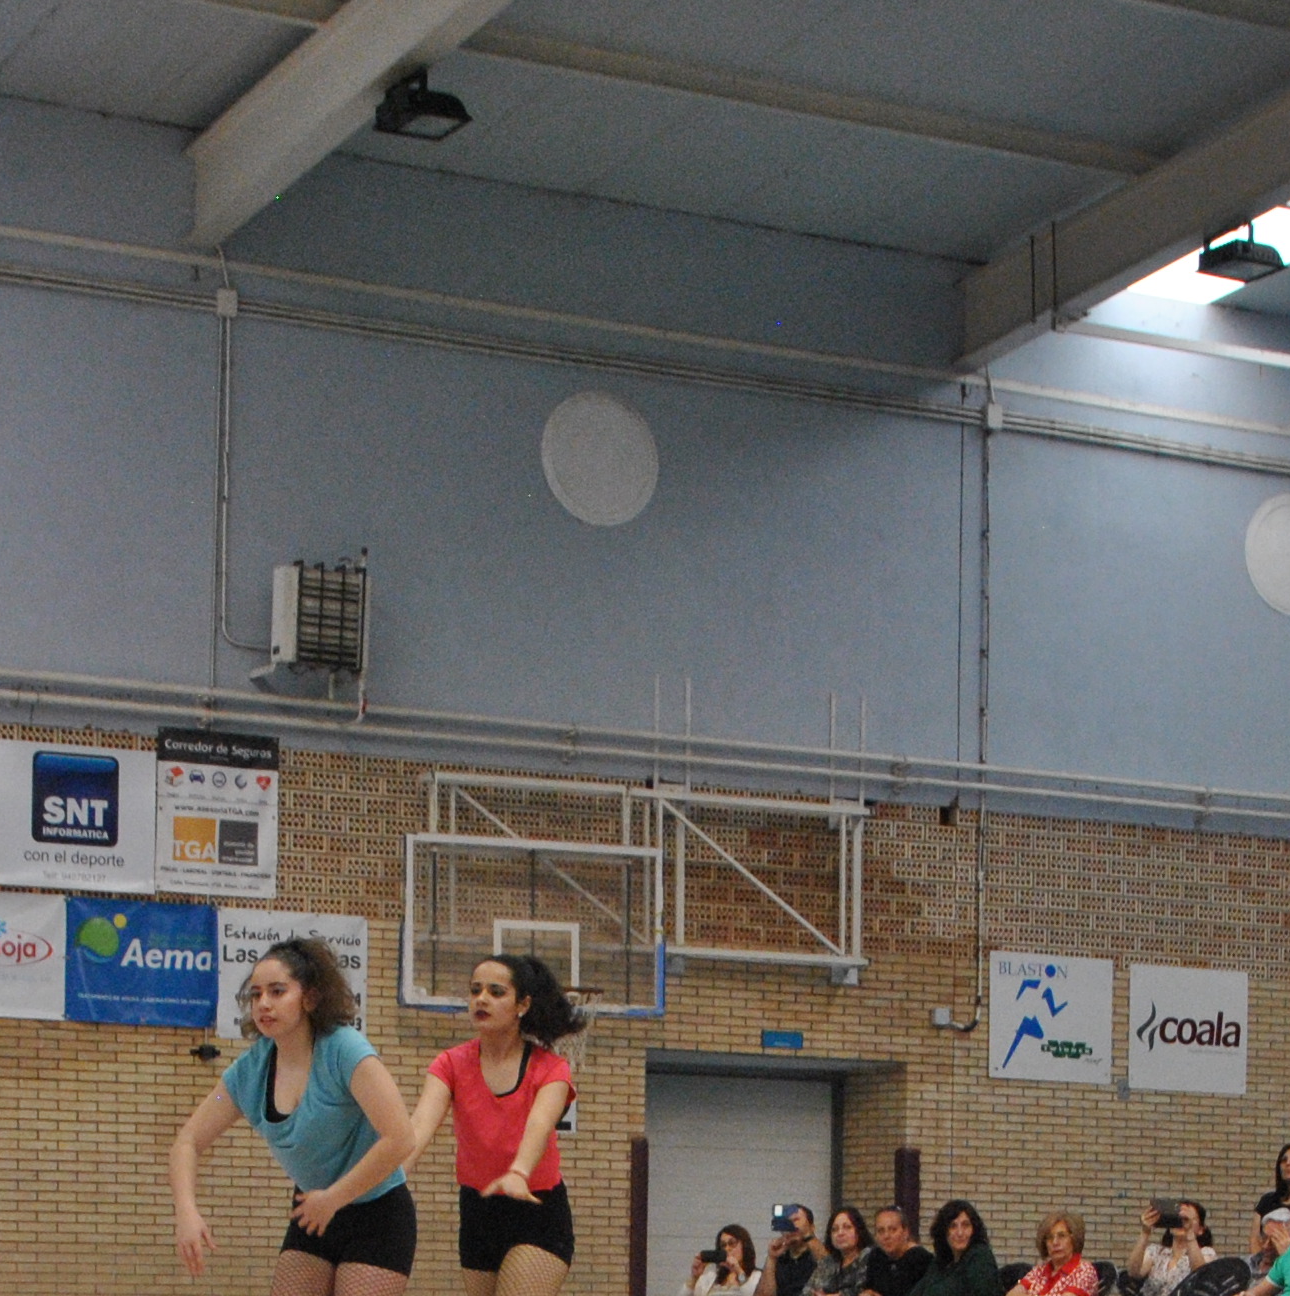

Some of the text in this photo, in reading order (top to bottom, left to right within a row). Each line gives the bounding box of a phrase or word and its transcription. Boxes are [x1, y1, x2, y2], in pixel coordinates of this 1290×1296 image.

[165, 738, 214, 753] Corredor
[216, 742, 228, 755] de
[231, 745, 272, 760] Seguros
[43, 795, 108, 827] SNT
[43, 826, 109, 840] INFORMATICA
[24, 851, 125, 868] con el deporte
[173, 840, 216, 860] TGA
[224, 924, 280, 941] Estación
[120, 938, 212, 971] Aema
[223, 945, 258, 963] Las
[1159, 1011, 1241, 1047] coala
